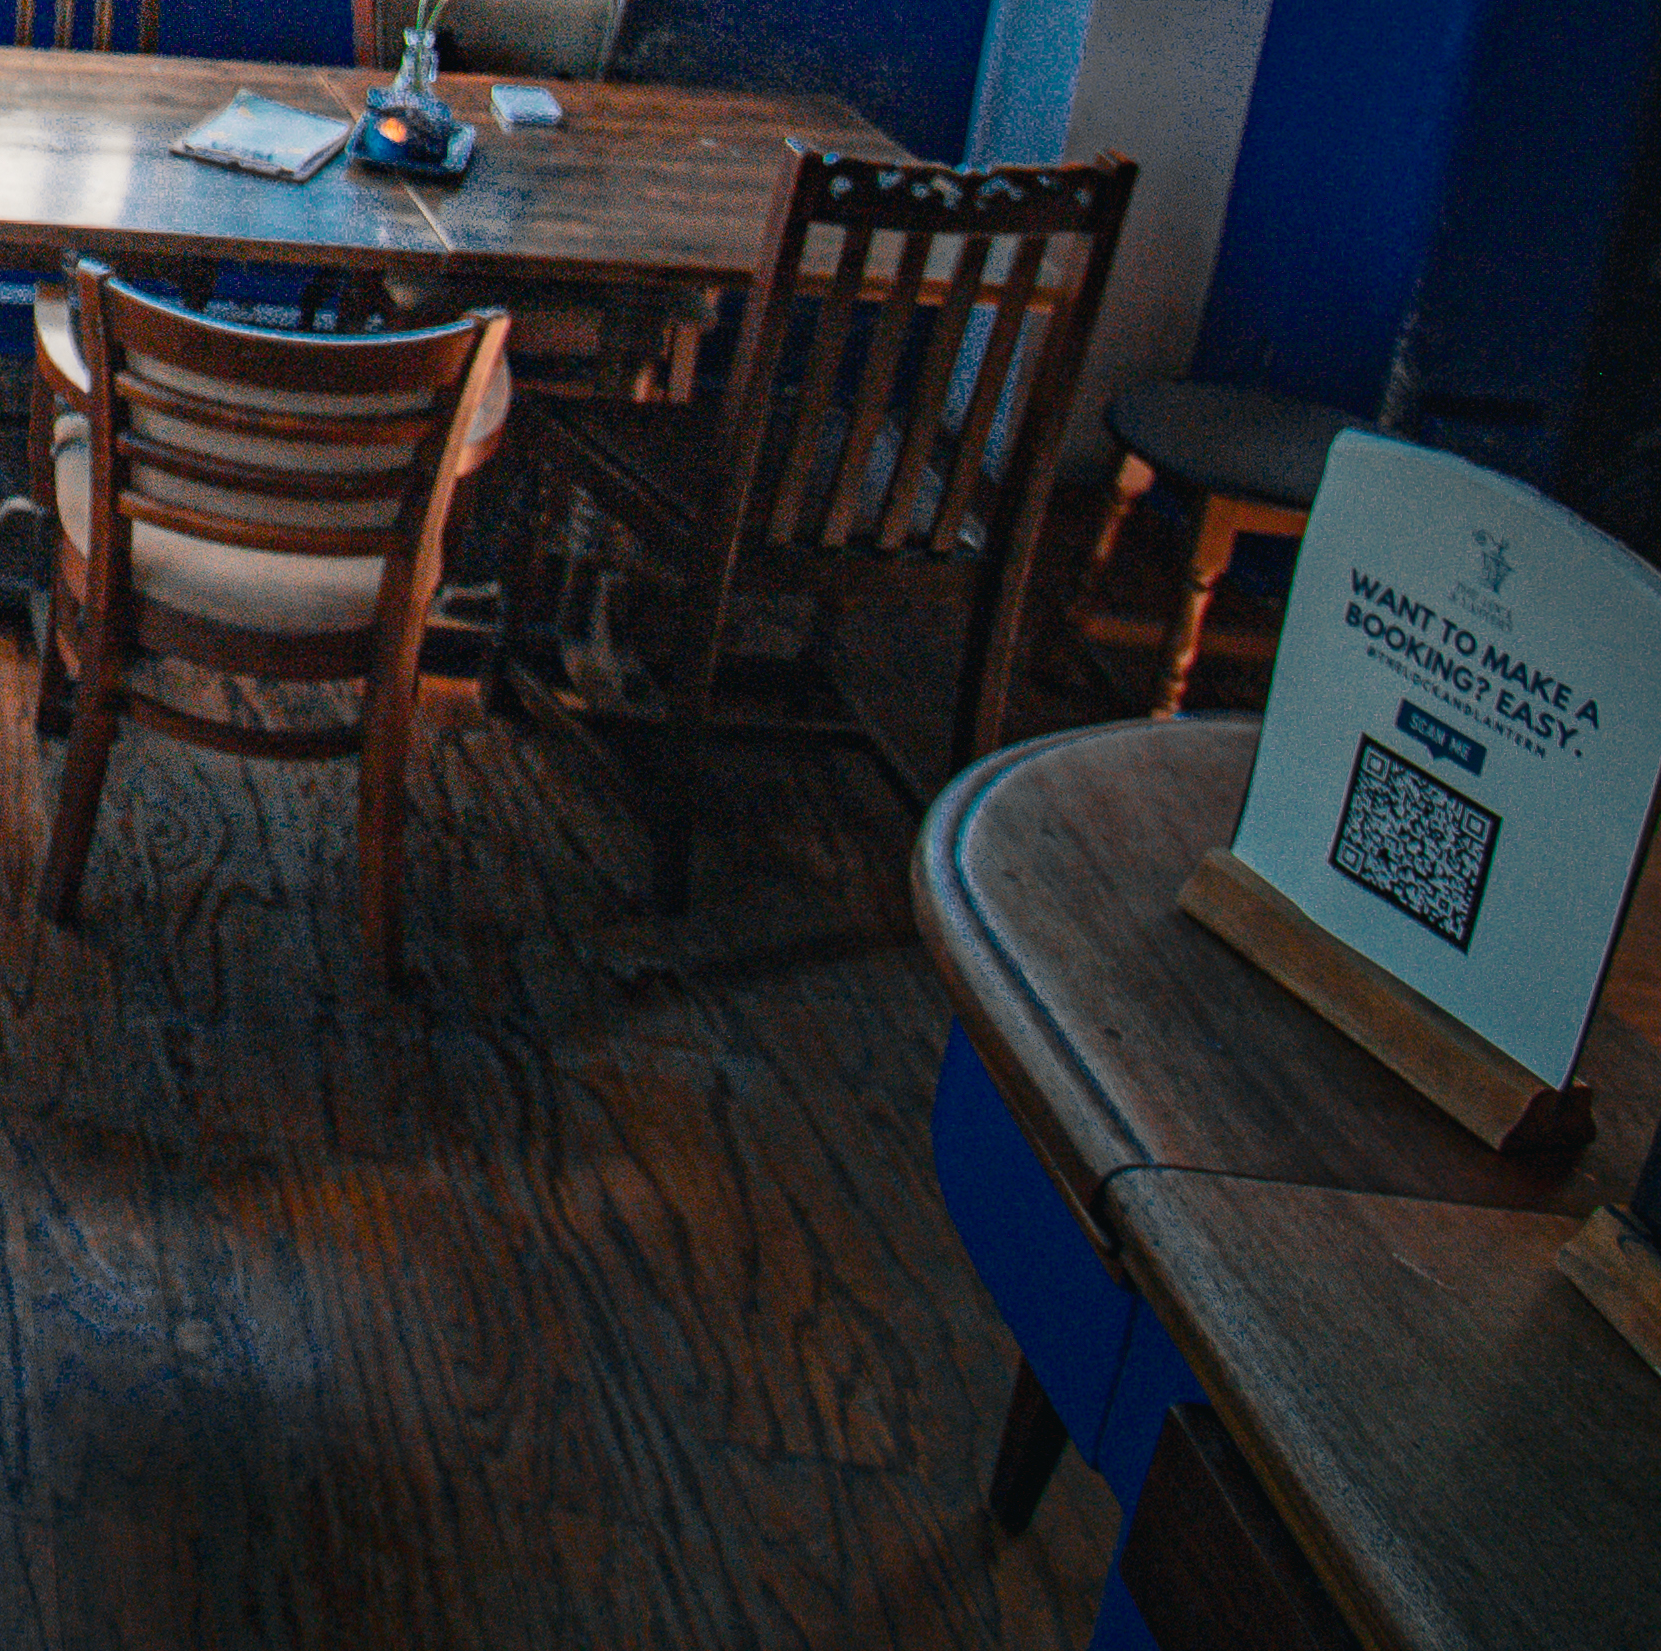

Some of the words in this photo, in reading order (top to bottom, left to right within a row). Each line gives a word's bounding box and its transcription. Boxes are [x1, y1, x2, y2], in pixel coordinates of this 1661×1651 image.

[1345, 600, 1491, 701] BOOKING?
[1496, 689, 1583, 757] EASY.
[1350, 566, 1436, 631] WANT
[1442, 617, 1477, 656] TO
[1482, 644, 1573, 711] MAKE
[1574, 699, 1599, 730] A
[1409, 712, 1447, 747] SCAN
[1448, 735, 1471, 761] ME
